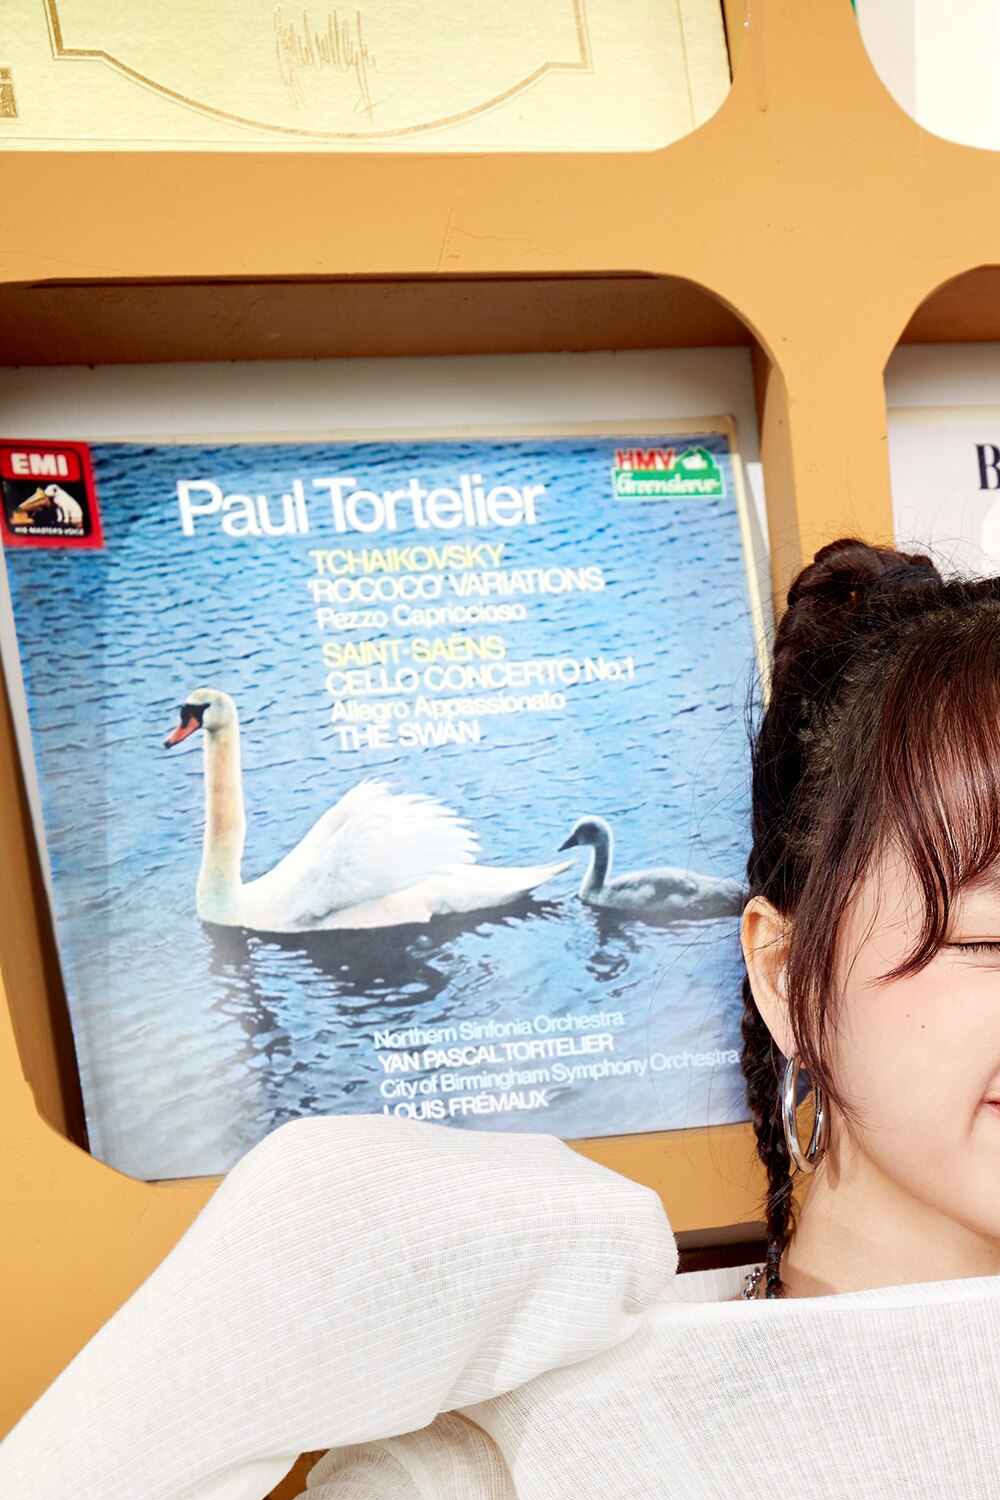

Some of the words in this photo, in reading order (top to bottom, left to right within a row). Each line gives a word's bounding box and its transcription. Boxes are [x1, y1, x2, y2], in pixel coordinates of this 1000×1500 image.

[10, 453, 69, 476] EMI
[615, 447, 677, 472] HMV
[176, 477, 310, 537] Paul
[312, 472, 546, 534] Tortelier
[308, 542, 505, 576] TCHAIKOVSKY
[449, 566, 605, 597] VARIATIONS
[315, 605, 389, 630] Pezzo
[391, 601, 527, 629] Capriccioso
[325, 667, 420, 697] CELLO
[423, 658, 580, 692] CONCERTO
[330, 700, 410, 724] Allegro
[413, 690, 567, 720] Appassionato
[331, 723, 391, 751] THE
[397, 718, 482, 746] SWAN
[373, 1025, 458, 1049] Northern
[459, 1018, 532, 1042] Sinfonia
[532, 1010, 625, 1034] Orchestra
[377, 1050, 420, 1074] YAN
[422, 1044, 502, 1070] PASCAL
[500, 1032, 615, 1062] TORTELIER
[380, 1079, 421, 1100] City
[418, 1075, 439, 1094] of
[440, 1067, 550, 1093] Birmingham
[551, 1057, 649, 1085] Symphony
[649, 1047, 741, 1072] Orchestra
